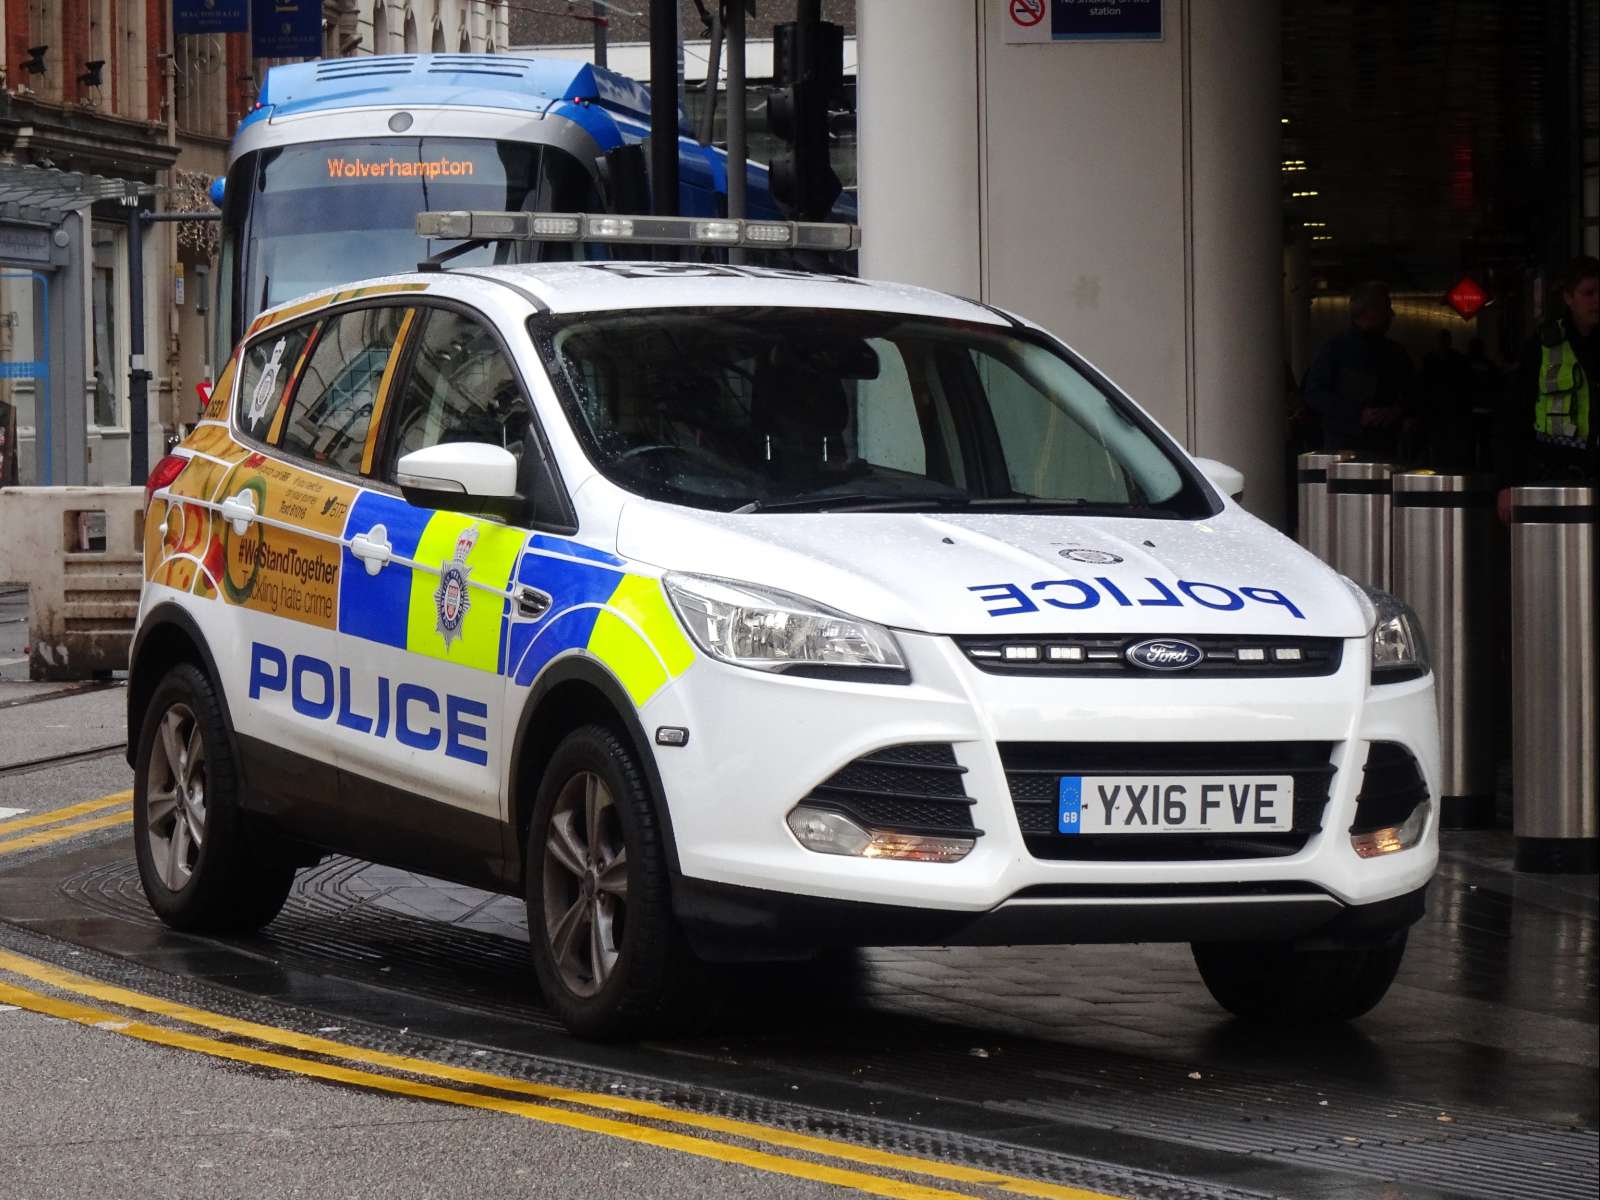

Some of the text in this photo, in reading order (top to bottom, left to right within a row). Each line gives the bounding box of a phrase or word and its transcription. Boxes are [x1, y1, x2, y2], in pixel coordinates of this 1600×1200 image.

[1089, 7, 1121, 16] station
[327, 157, 474, 181] Wolverhampton
[238, 538, 338, 585] #WeStandTogether
[280, 578, 302, 611] hate
[304, 586, 333, 618] crime
[1146, 643, 1188, 663] Ford
[249, 641, 488, 766] POLICE
[1062, 811, 1078, 824] GB
[1097, 784, 1278, 826] YX16 FVE
